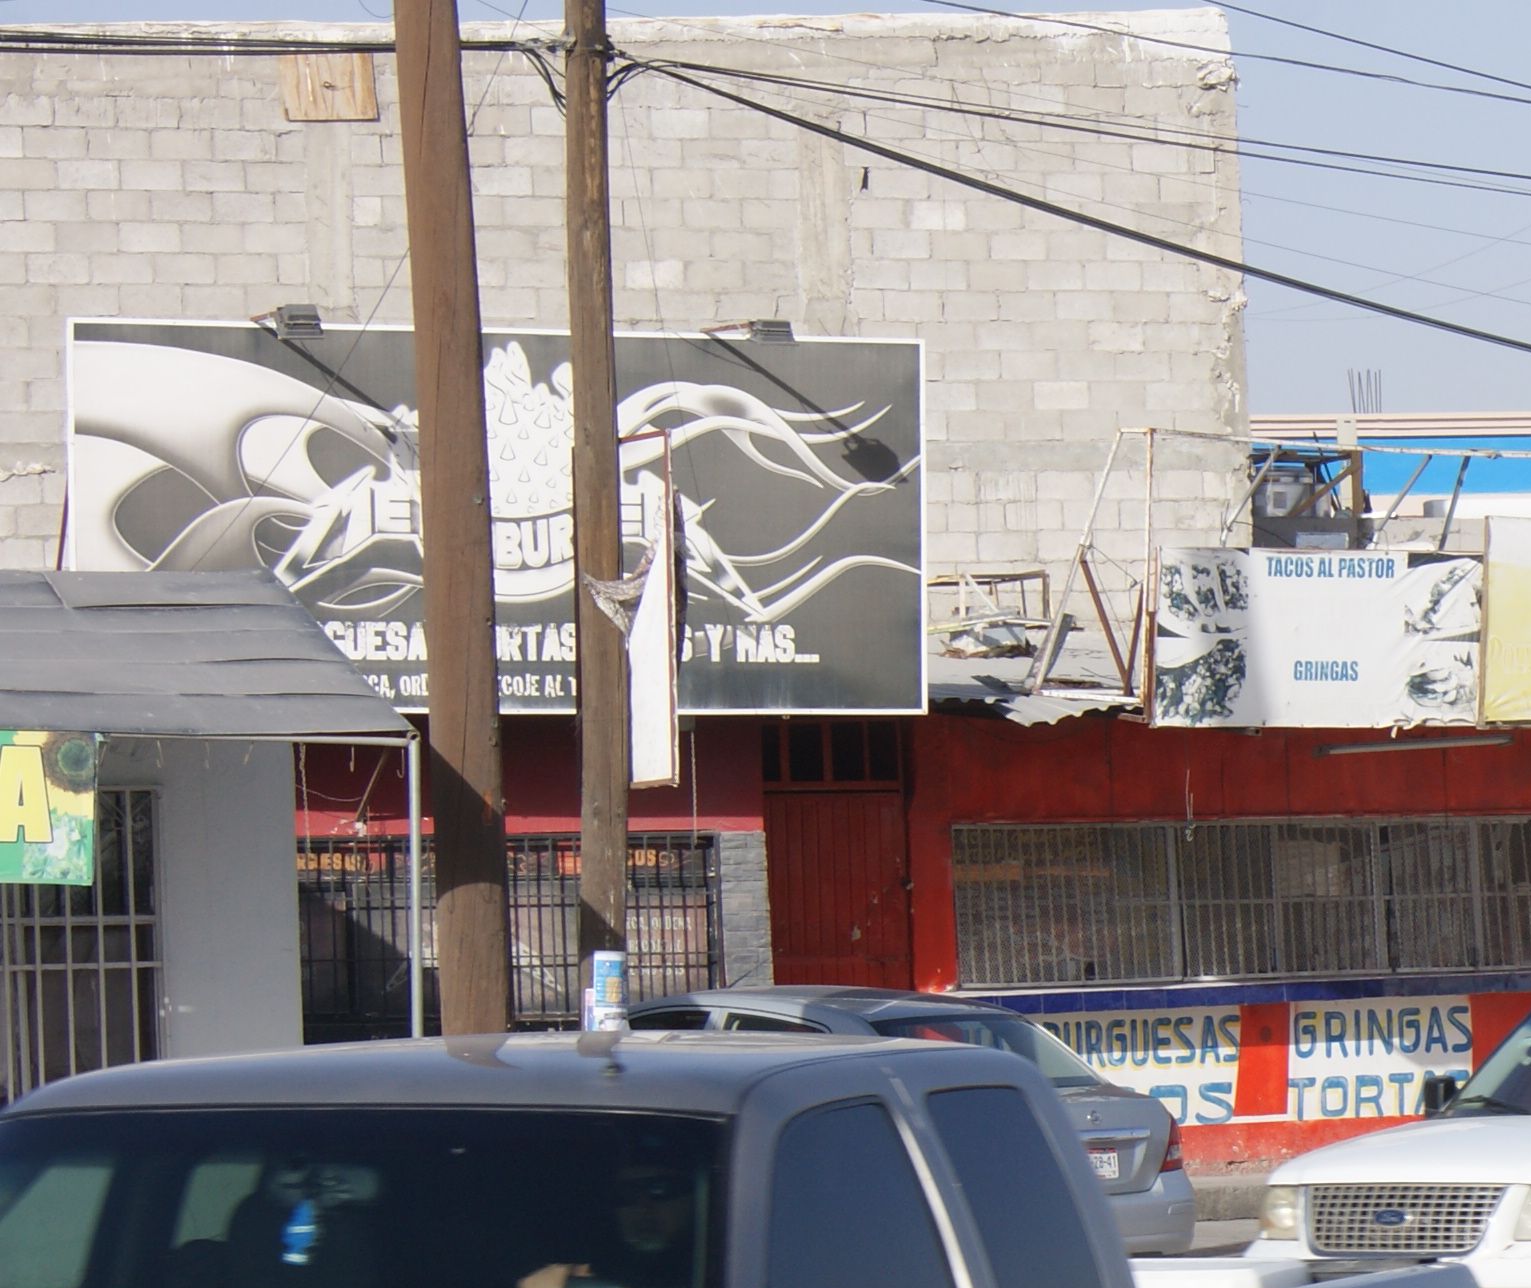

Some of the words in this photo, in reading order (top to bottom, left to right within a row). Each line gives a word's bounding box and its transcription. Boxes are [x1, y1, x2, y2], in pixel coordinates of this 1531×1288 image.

[1266, 556, 1314, 577] TACOS
[1317, 557, 1334, 578] AL
[1338, 558, 1395, 578] PASTOR
[324, 621, 428, 661] GUESA
[1293, 660, 1359, 681] GRINGAS
[1294, 1005, 1474, 1060] GRINGAS
